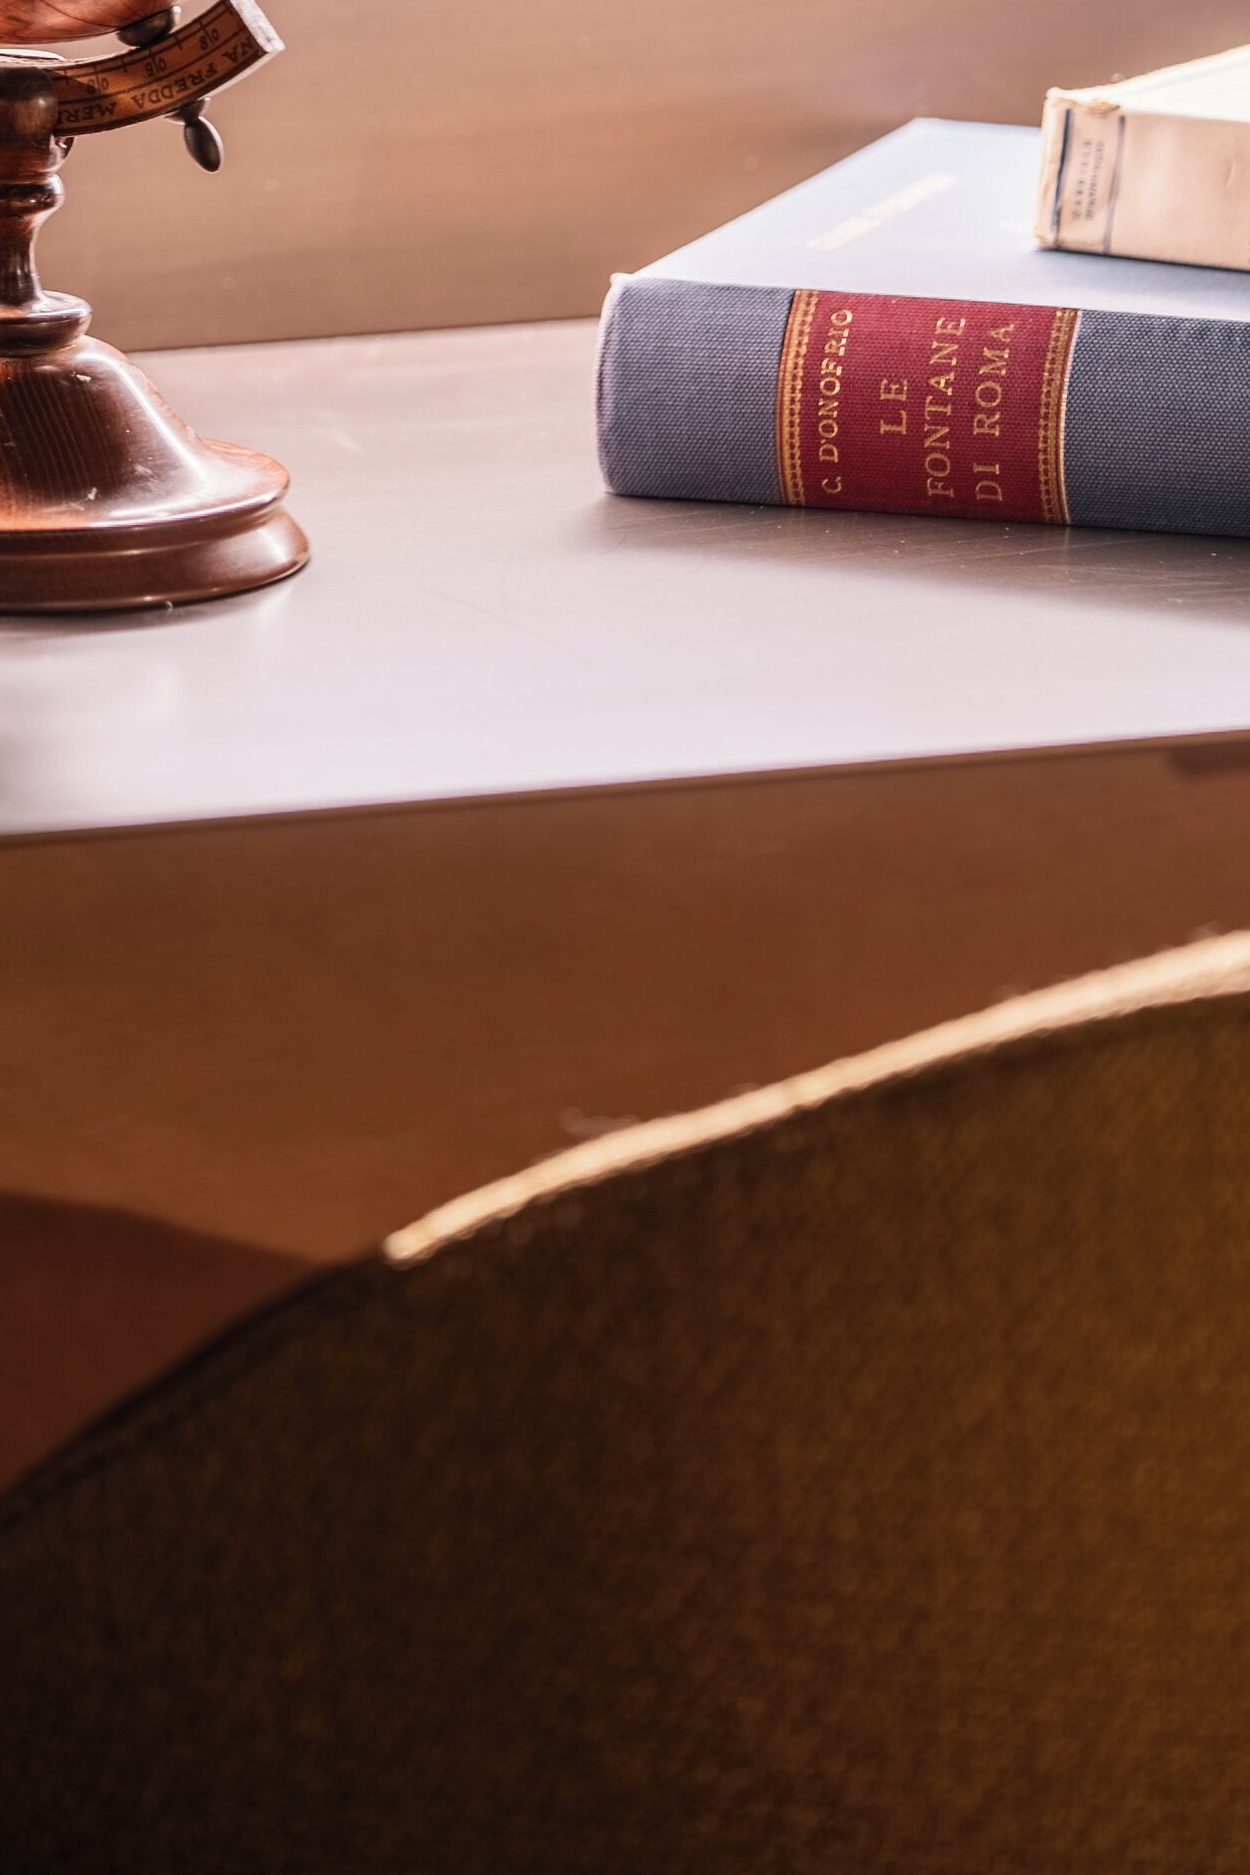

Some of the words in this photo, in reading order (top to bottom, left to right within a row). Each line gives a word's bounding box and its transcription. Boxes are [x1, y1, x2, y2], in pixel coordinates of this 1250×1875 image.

[200, 27, 220, 52] 80
[130, 61, 219, 110] FREDDA
[818, 308, 853, 464] D'ONOFRIO
[879, 378, 908, 436] LE
[923, 317, 966, 498] FONTANE
[973, 324, 1015, 437] ROMA
[973, 462, 1003, 502] DI
